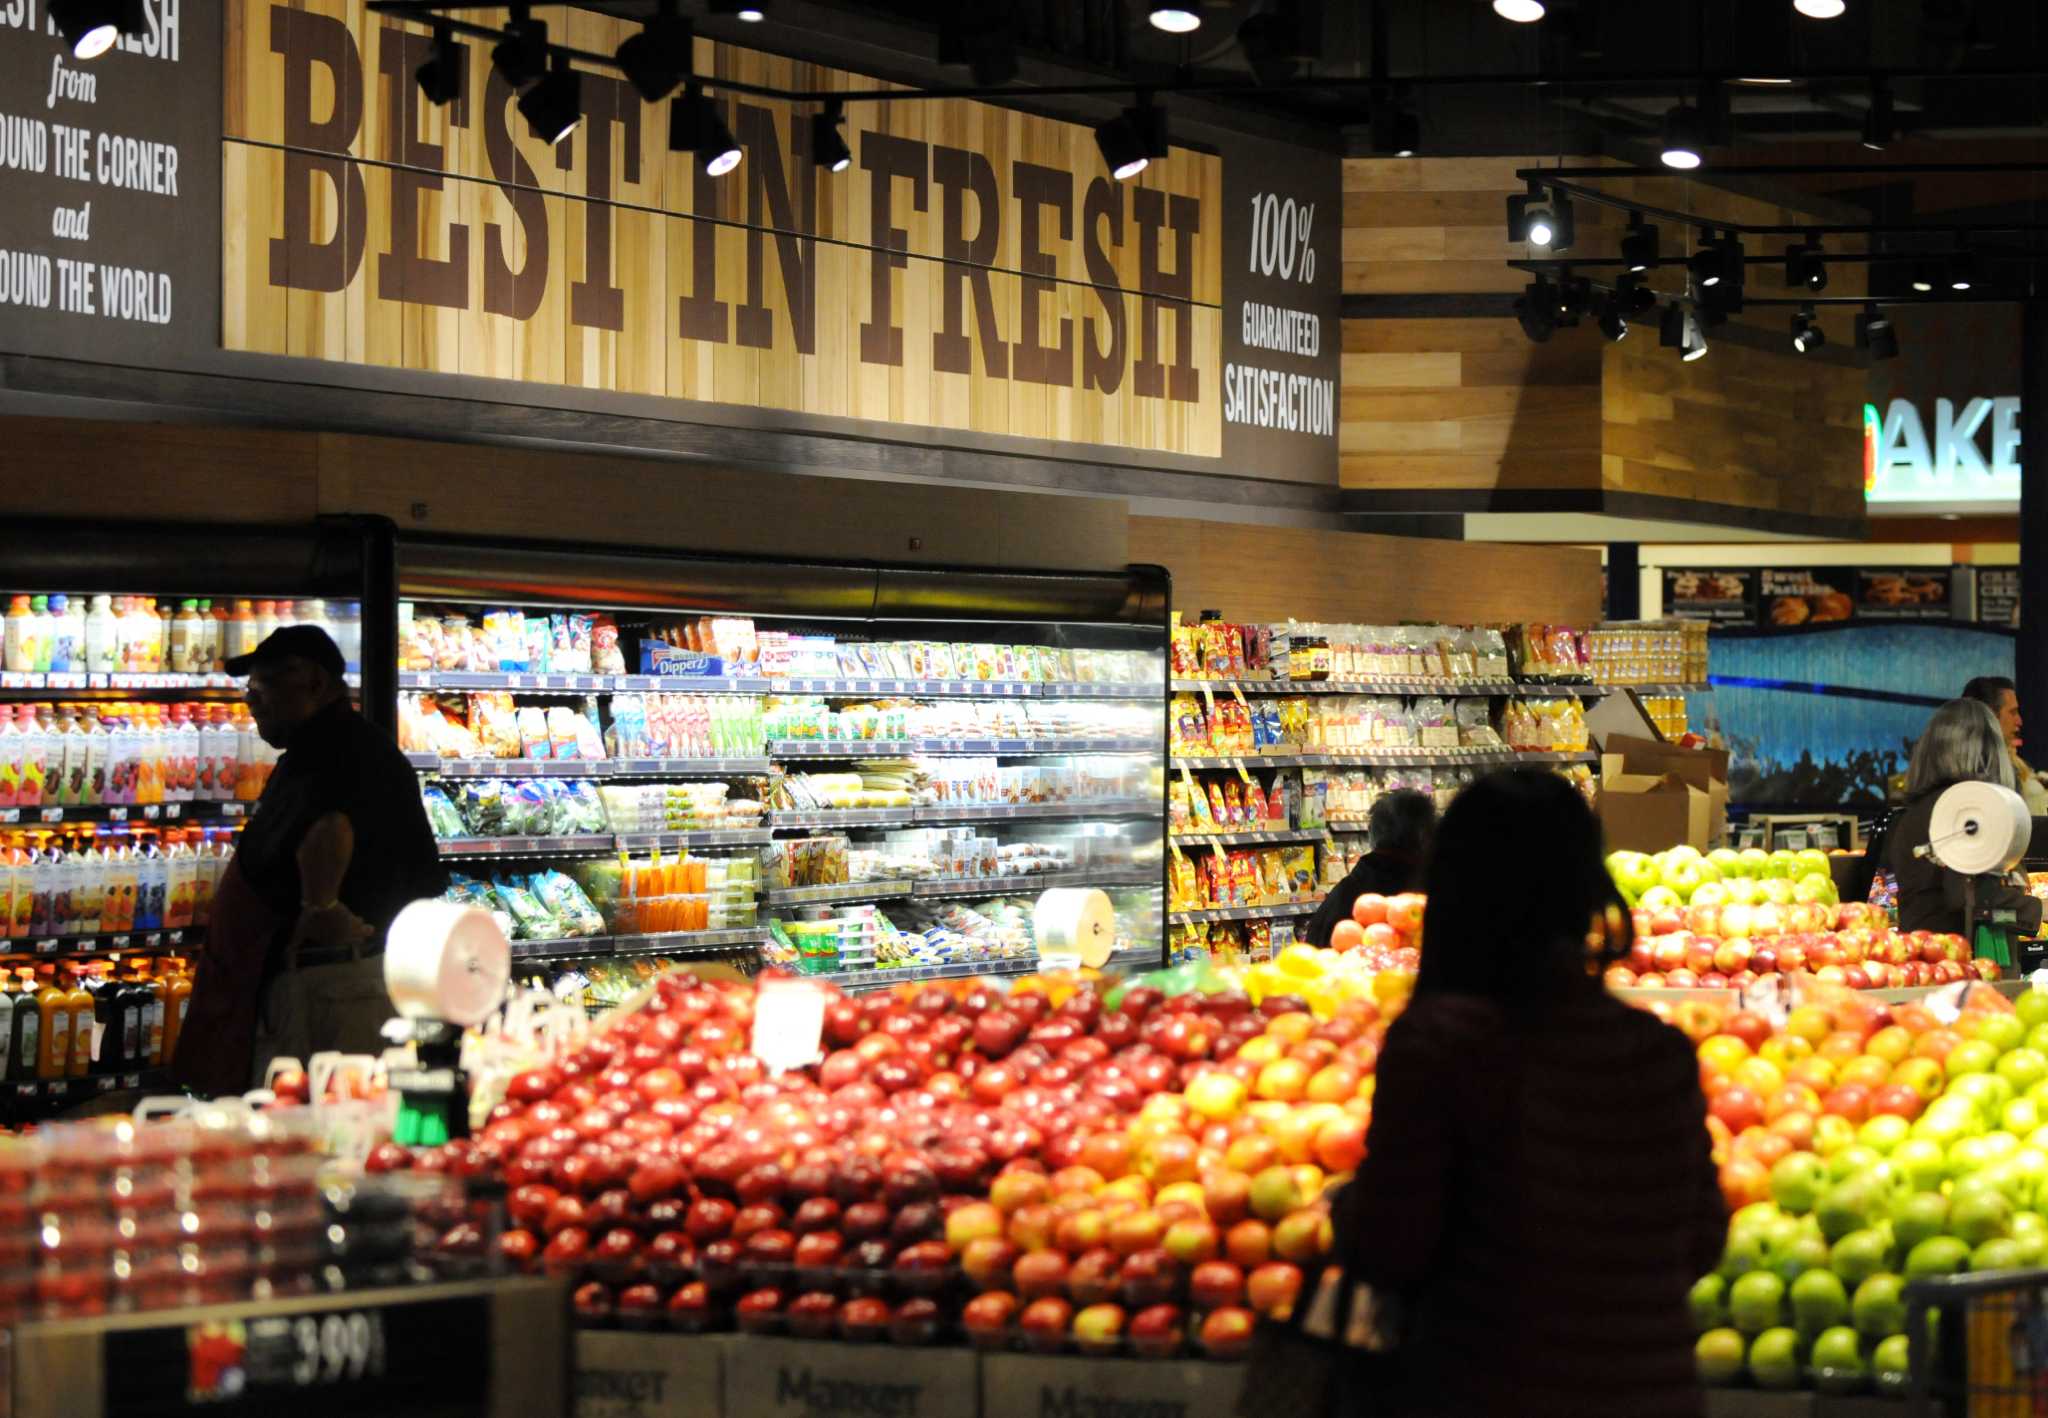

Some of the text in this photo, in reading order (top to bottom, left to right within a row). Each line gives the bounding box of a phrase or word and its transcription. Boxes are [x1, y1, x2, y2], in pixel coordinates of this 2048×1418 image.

[47, 54, 97, 109] from
[52, 123, 91, 182] THE
[97, 132, 178, 197] CORNER
[52, 200, 91, 241] and
[269, 4, 1200, 403] BEST IN FRESH
[1250, 191, 1316, 284] 100%
[57, 258, 96, 315] THE
[100, 264, 172, 324] WORLD
[1242, 300, 1320, 357] GUARANTEED
[1225, 362, 1334, 436] SATISFACTION
